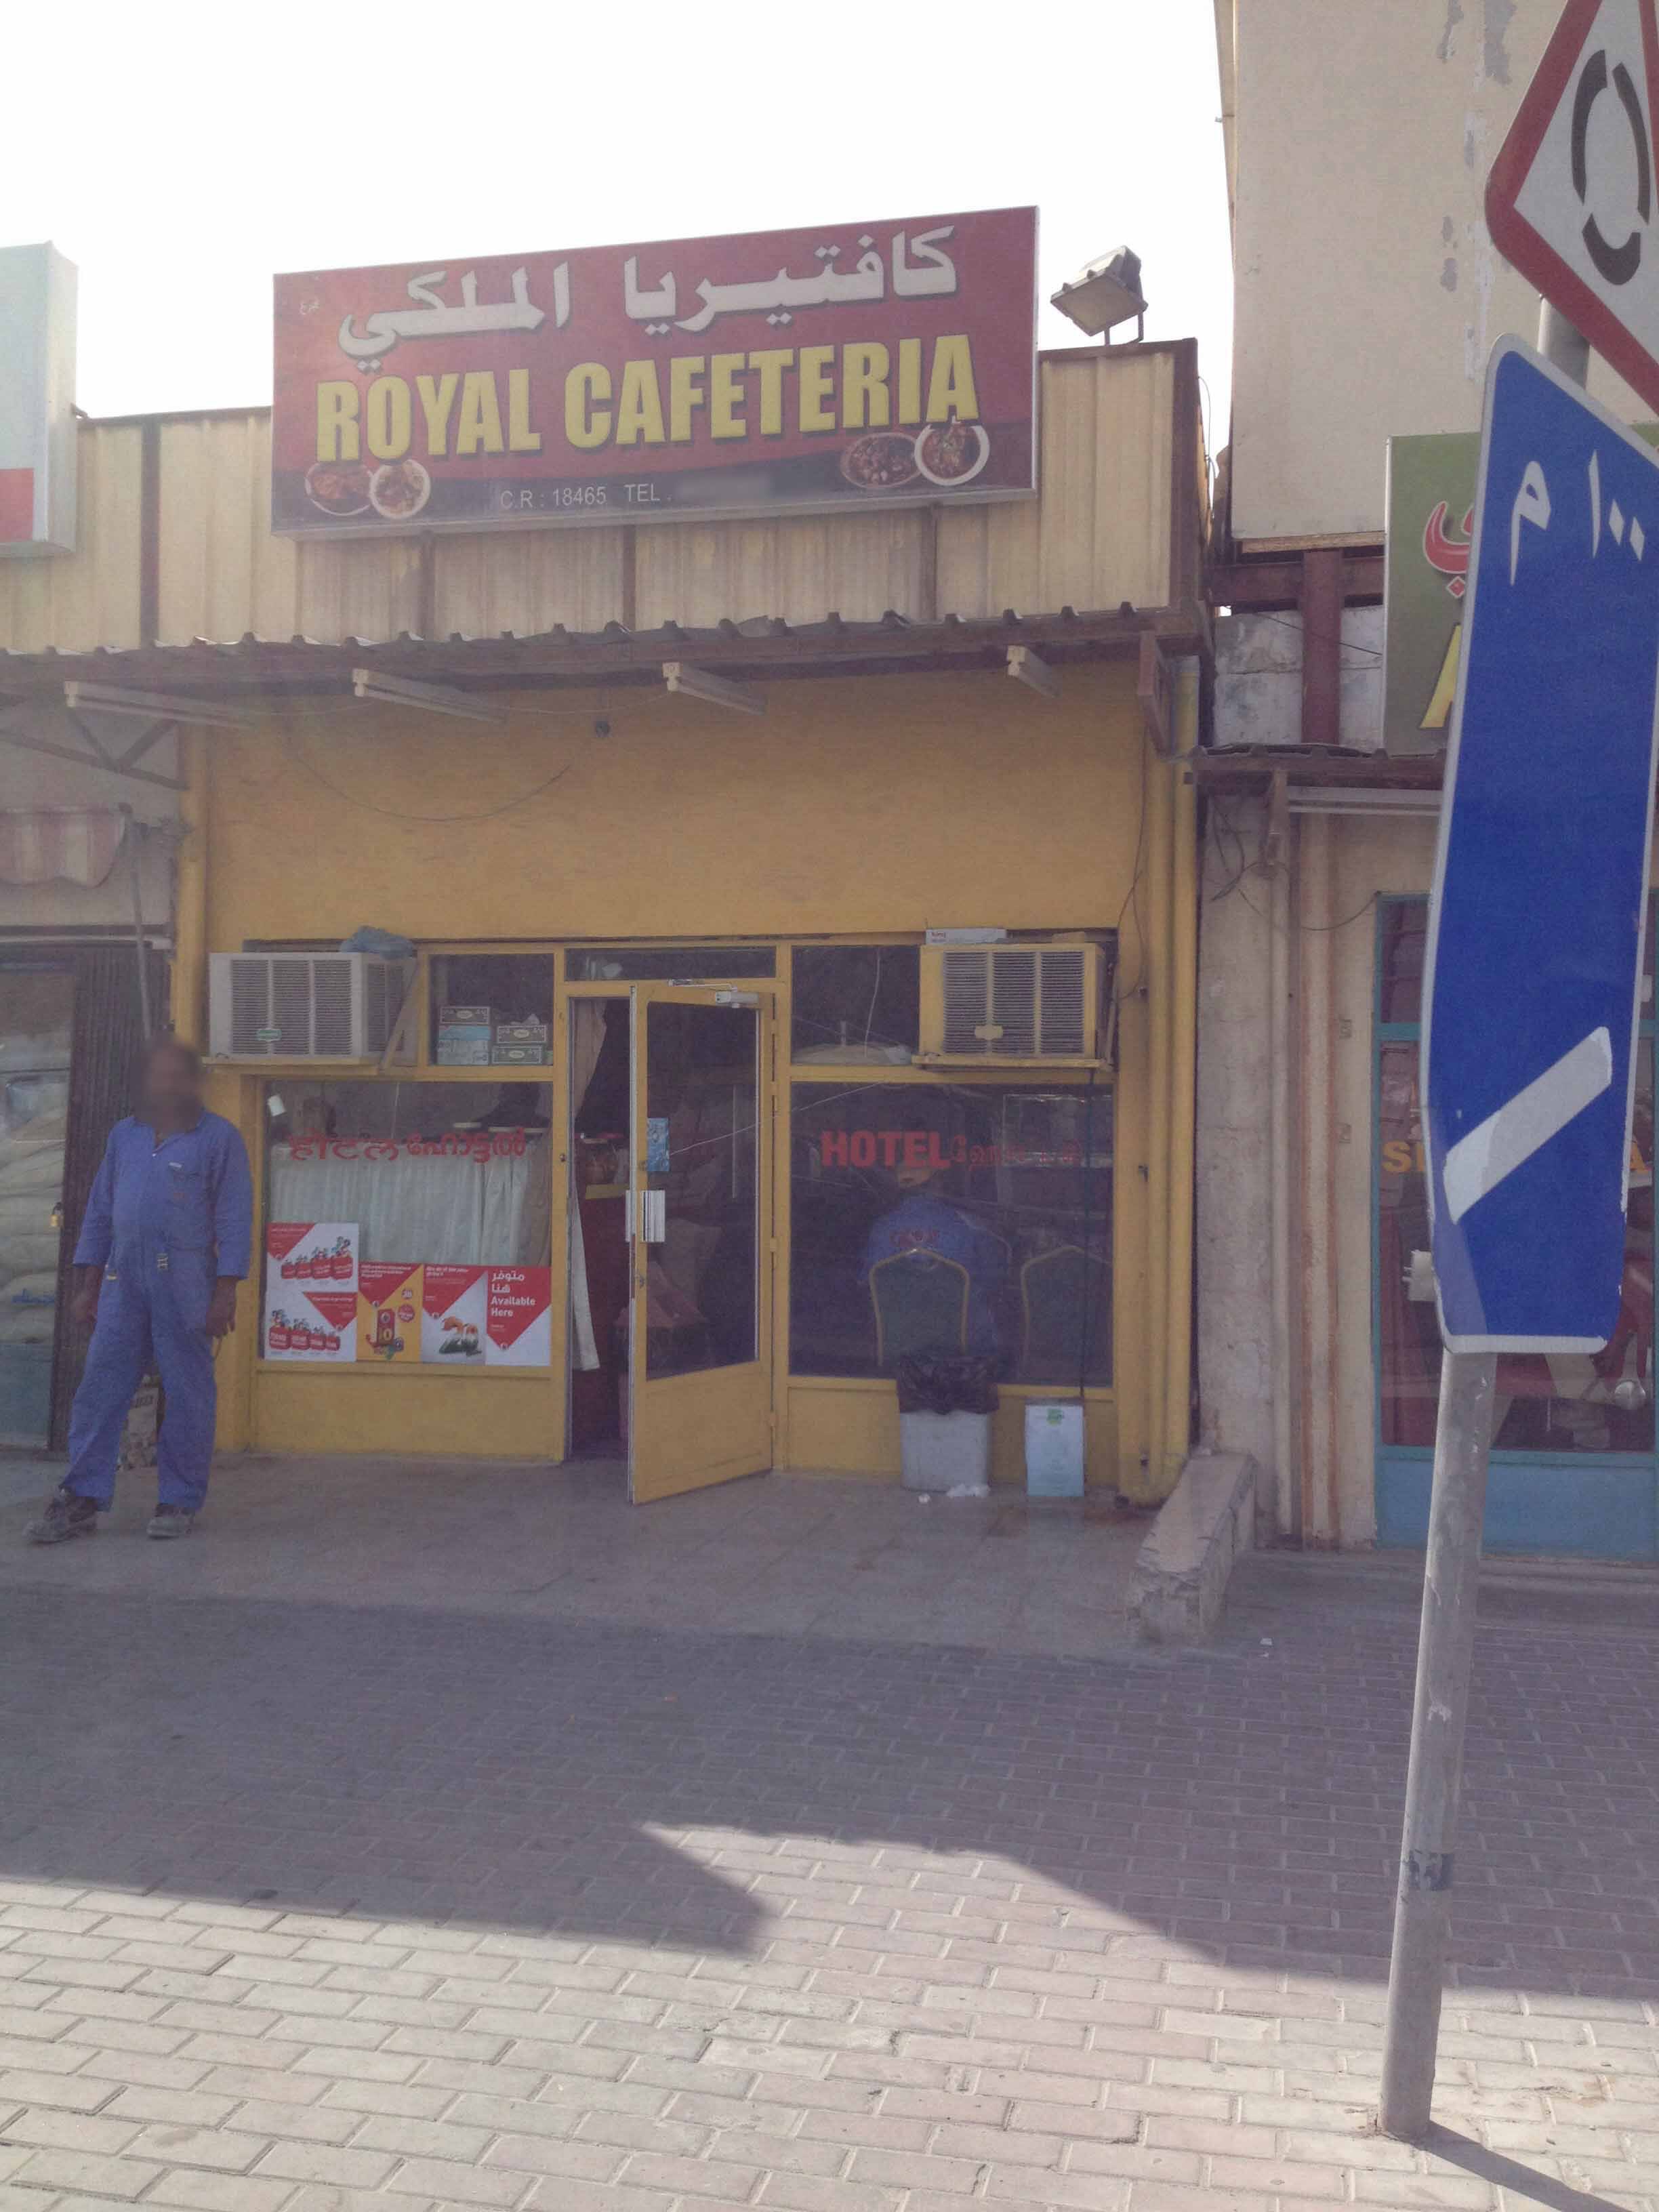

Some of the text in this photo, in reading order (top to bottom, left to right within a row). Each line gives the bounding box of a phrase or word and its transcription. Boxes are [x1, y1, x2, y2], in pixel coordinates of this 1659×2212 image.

[338, 226, 956, 371] كافتيريا الملكي
[316, 335, 979, 462] ROYAL CAFETERIA
[552, 486, 607, 506] 18465
[820, 1130, 950, 1168] HOTEL
[491, 1296, 536, 1306] Available
[491, 1308, 513, 1317] Here
